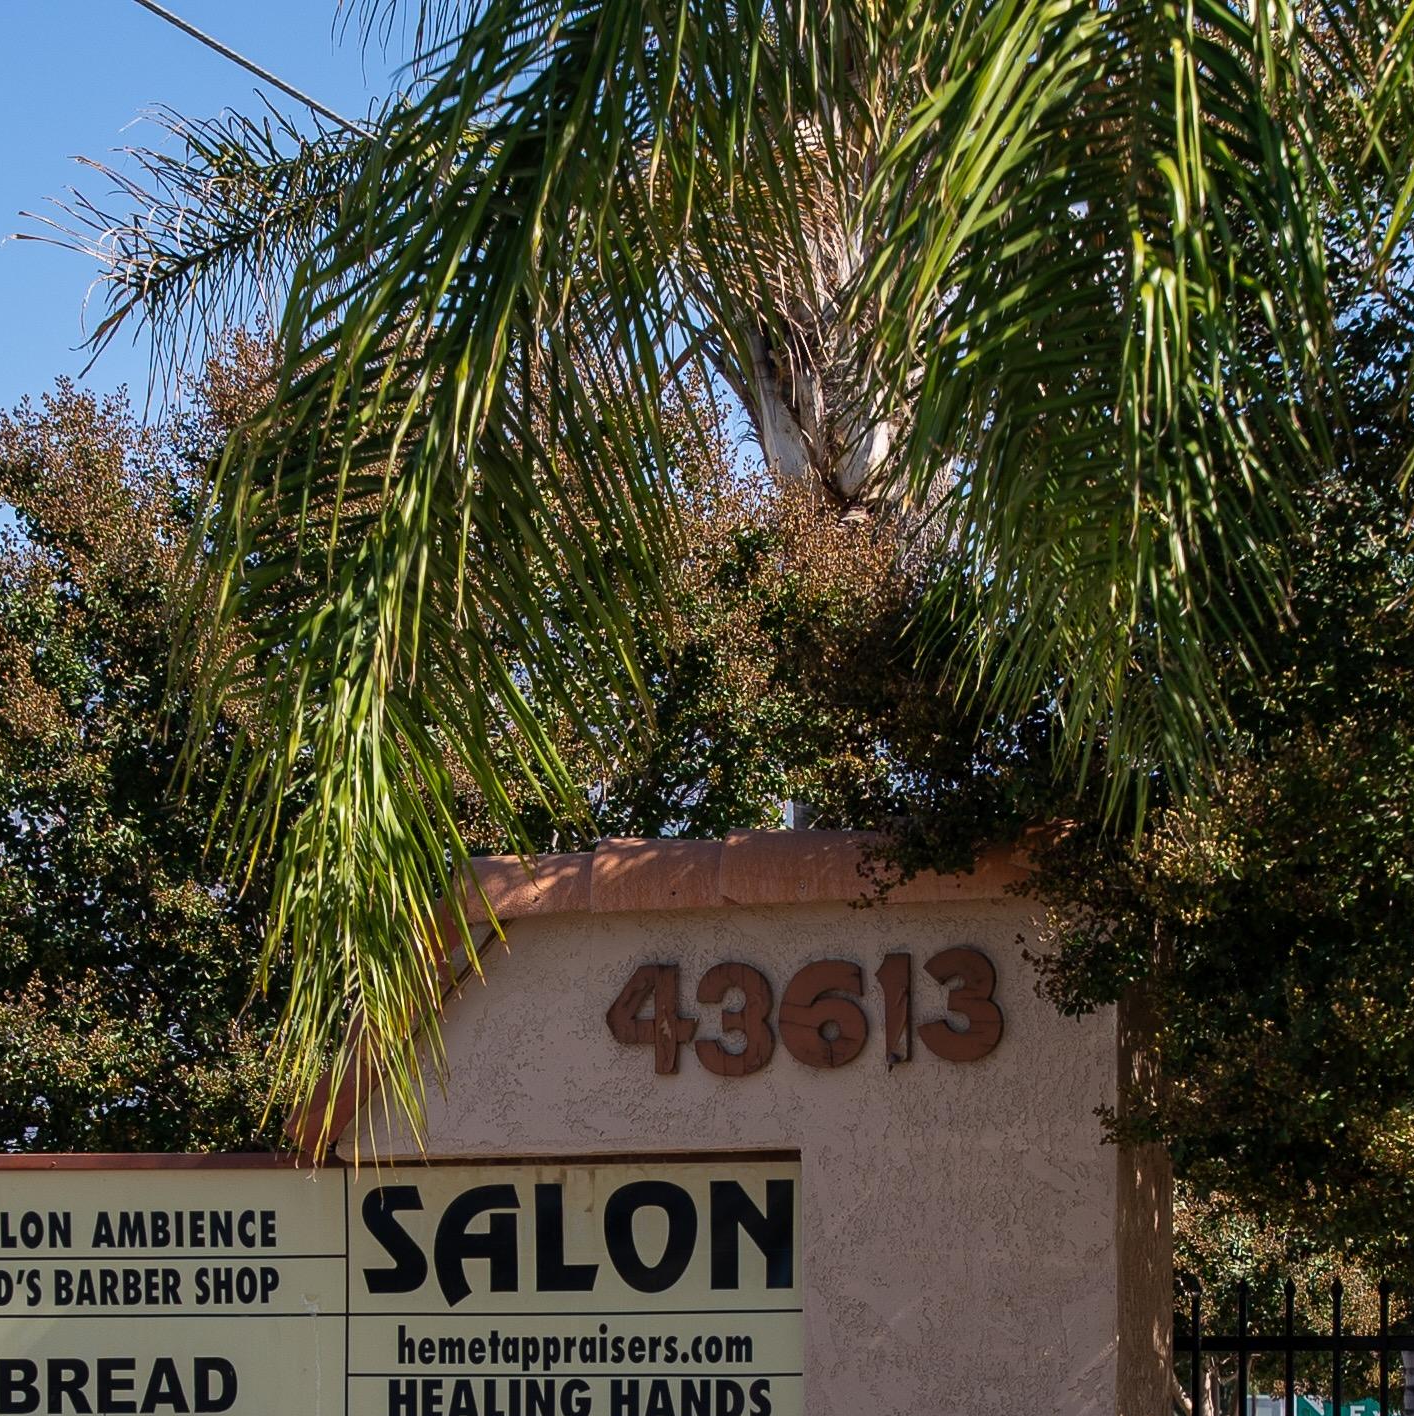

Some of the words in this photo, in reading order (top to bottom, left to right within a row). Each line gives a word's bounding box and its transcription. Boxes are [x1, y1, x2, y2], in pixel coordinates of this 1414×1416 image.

[606, 947, 1004, 1076] 43613
[91, 1209, 277, 1249] AMBIENCE
[361, 1179, 795, 1308] SALON
[54, 1267, 183, 1306] BARBER
[194, 1266, 280, 1305] SHOP
[397, 1323, 753, 1371] hemetappraisers.com
